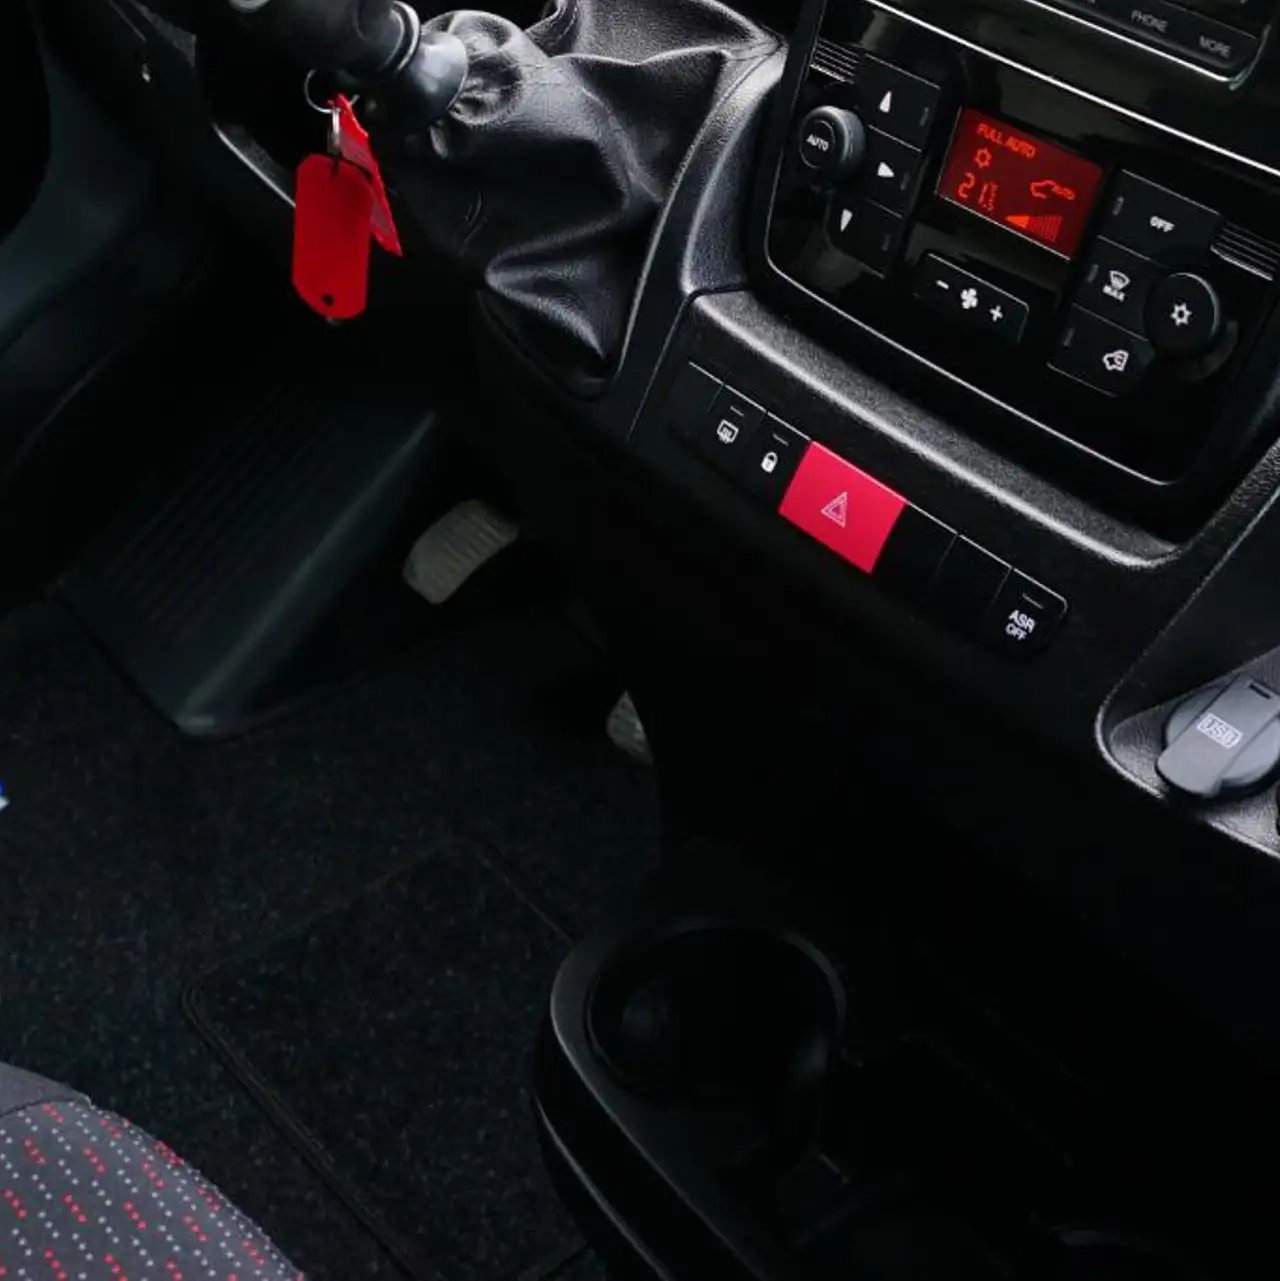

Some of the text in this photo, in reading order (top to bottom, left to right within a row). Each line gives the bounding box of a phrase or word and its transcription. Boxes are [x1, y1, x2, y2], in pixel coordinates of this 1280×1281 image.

[1130, 8, 1169, 33] PHONE
[1199, 34, 1231, 59] MORE
[976, 122, 1037, 159] FULL AUTO
[1149, 215, 1176, 233] OFF
[1005, 622, 1028, 640] OFF
[1008, 609, 1036, 634] ASR
